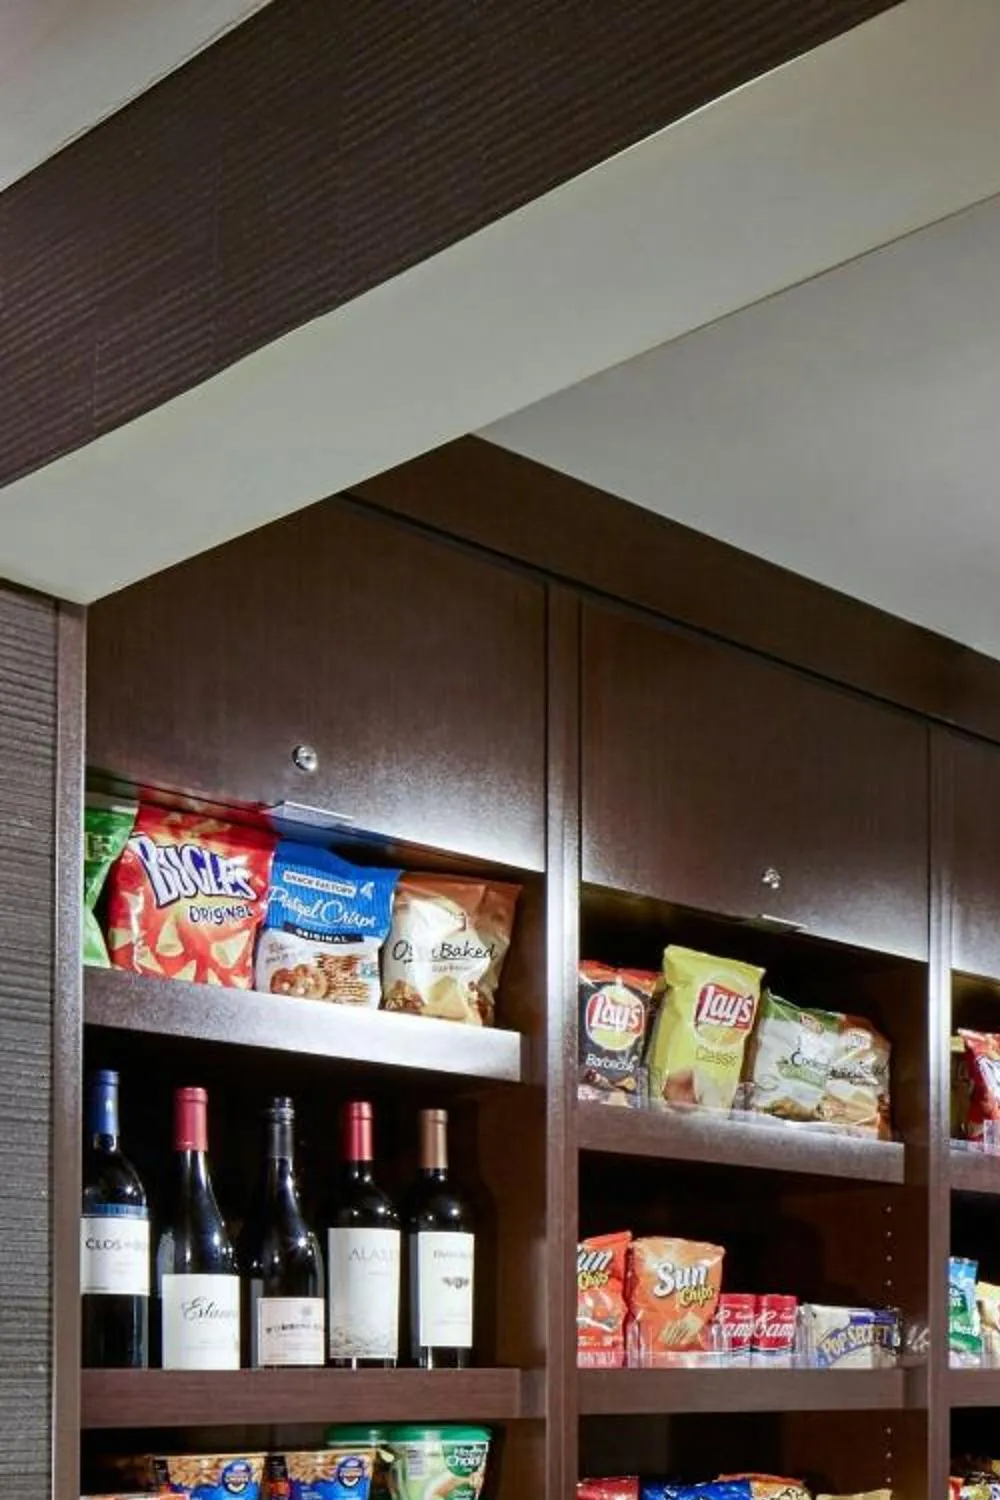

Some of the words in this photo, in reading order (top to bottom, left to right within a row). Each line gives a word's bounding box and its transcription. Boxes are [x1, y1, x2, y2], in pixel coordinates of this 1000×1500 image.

[591, 994, 643, 1032] Lay's
[698, 983, 754, 1029] Lay's
[577, 1249, 615, 1272] un
[653, 1261, 708, 1298] Sun
